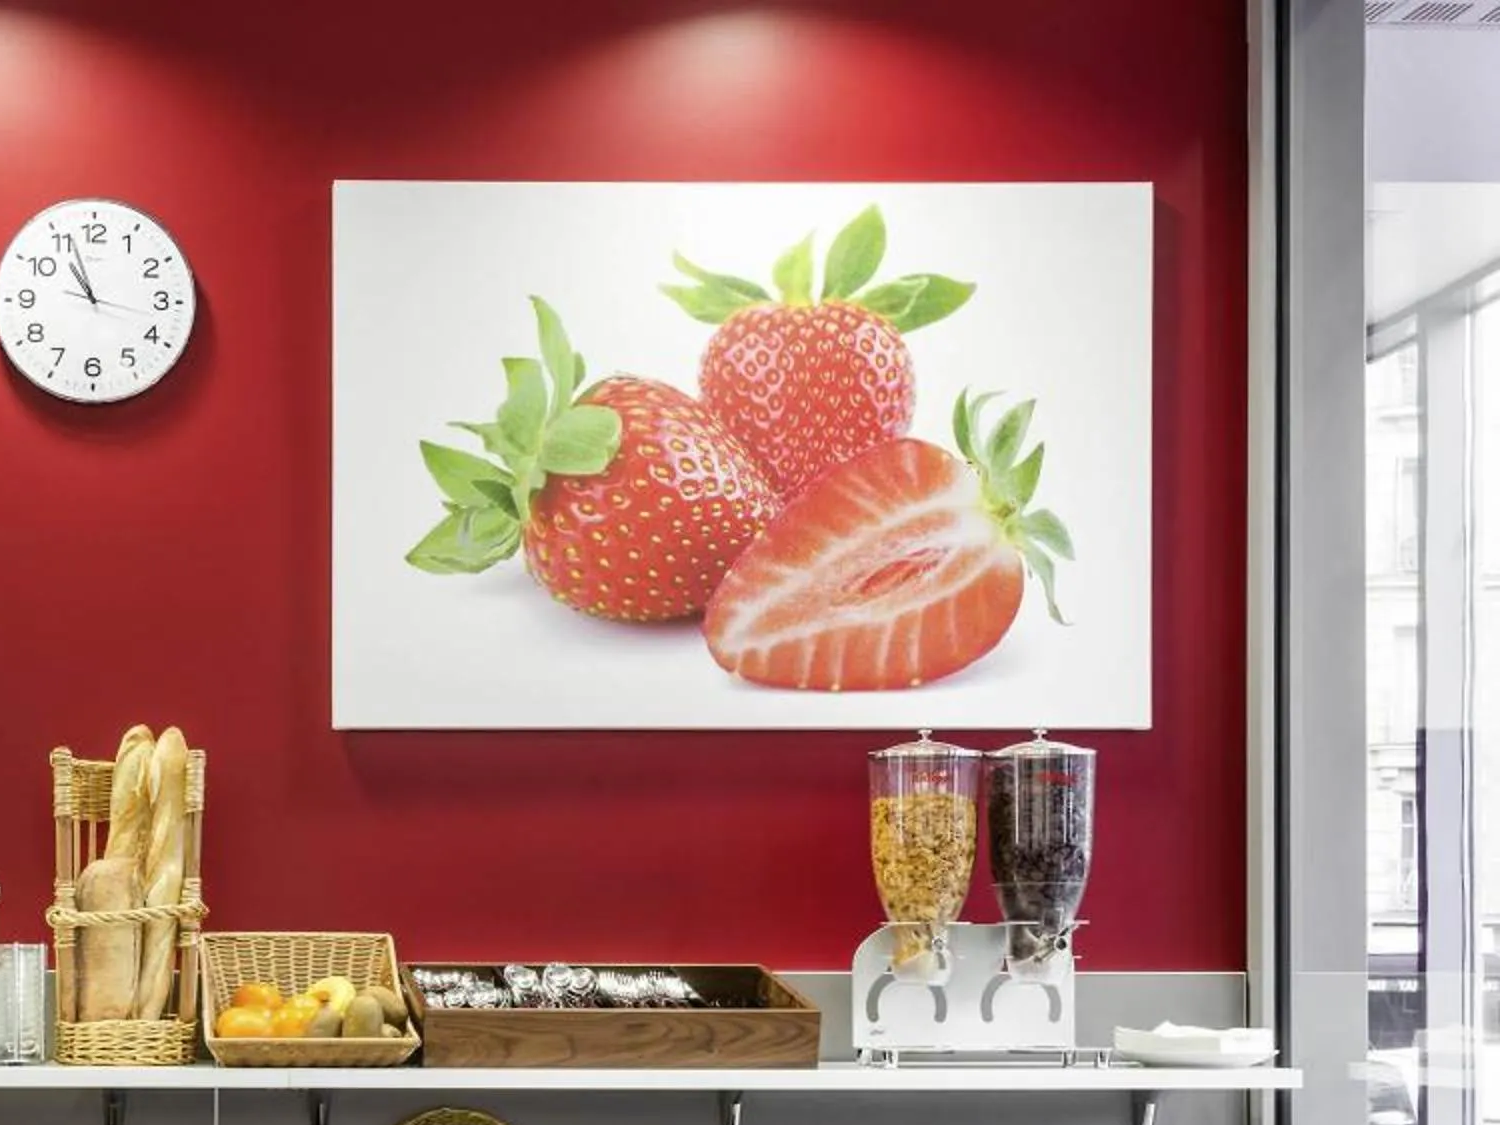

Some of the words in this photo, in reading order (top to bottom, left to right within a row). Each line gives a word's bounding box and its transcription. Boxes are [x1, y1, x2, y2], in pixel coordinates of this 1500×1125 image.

[52, 233, 73, 253] 11
[82, 223, 107, 244] 12
[122, 234, 132, 254] 1
[28, 256, 57, 277] 10
[143, 258, 160, 279] 2
[18, 288, 36, 309] 9
[153, 291, 169, 311] 3
[27, 322, 45, 343] 8
[143, 325, 160, 345] 4
[51, 347, 66, 367] 7
[84, 357, 102, 377] 6
[120, 348, 136, 368] 5
